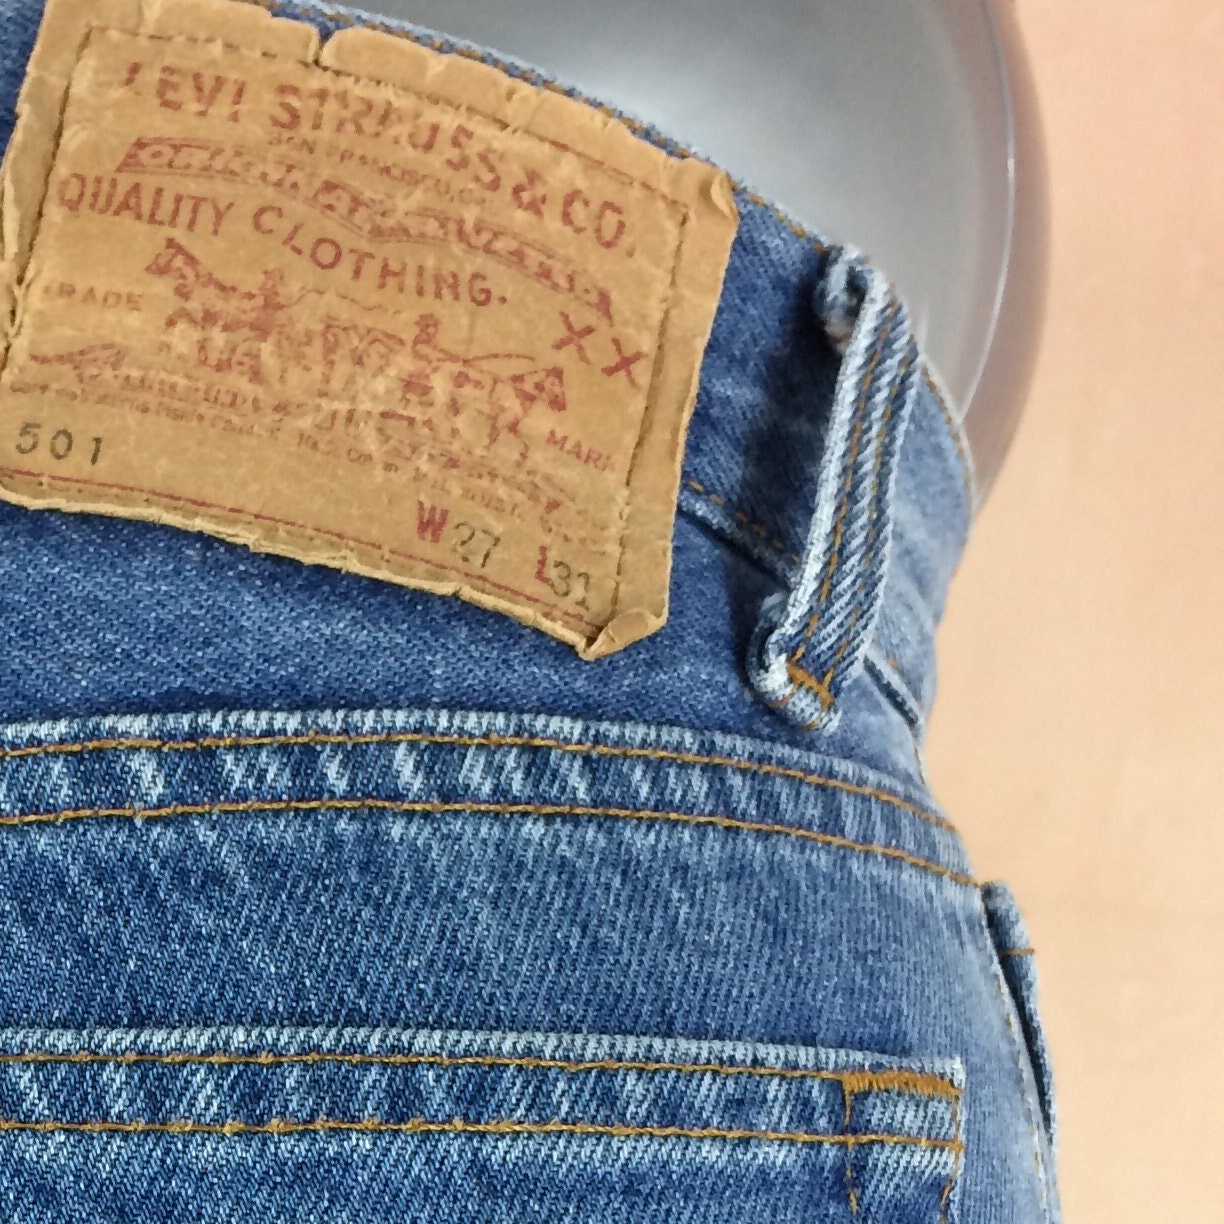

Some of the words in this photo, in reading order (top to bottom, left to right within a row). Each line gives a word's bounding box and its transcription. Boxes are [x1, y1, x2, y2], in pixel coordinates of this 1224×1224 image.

[57, 172, 235, 237] QUALITY
[251, 205, 509, 307] CLOTHING.
[14, 421, 104, 466] 501
